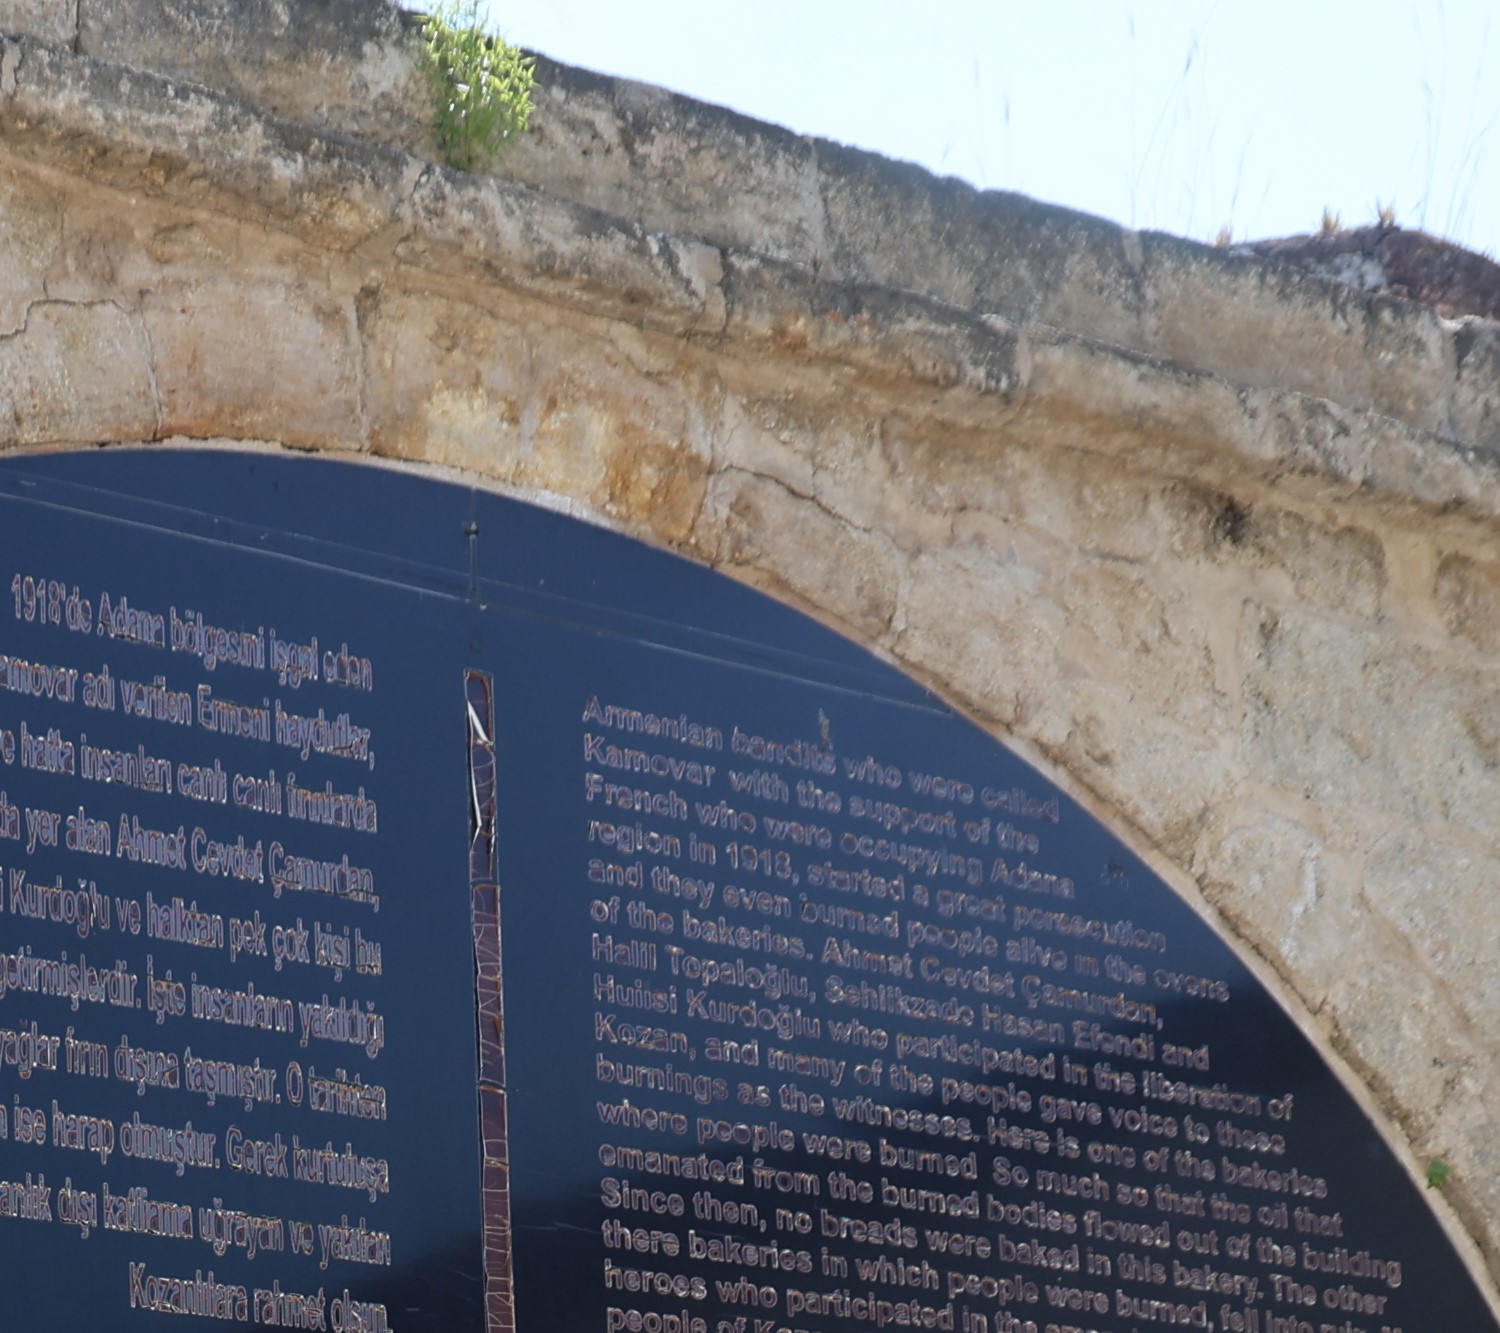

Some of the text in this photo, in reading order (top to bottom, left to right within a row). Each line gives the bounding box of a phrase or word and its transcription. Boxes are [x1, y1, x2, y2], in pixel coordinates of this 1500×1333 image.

[584, 775, 1074, 898] French who were occupying Adana
[590, 894, 620, 924] of
[625, 899, 674, 934] the
[682, 908, 813, 960] bakeries.
[820, 936, 913, 979] Ahmet
[919, 957, 1015, 998] Cevdet
[594, 1011, 696, 1061] Kozan,
[704, 1036, 759, 1066] and
[767, 1046, 846, 1087] many
[852, 1058, 882, 1087] of
[887, 1063, 933, 1095] the
[941, 1076, 1032, 1114] people
[1038, 1094, 1102, 1125] gave
[1106, 1105, 1178, 1138] voice
[1182, 1114, 1209, 1144] to
[595, 1097, 687, 1134] where
[696, 1117, 795, 1153] people
[801, 1131, 872, 1163] were
[992, 1155, 1030, 1187] So
[1035, 1168, 1109, 1201] much
[1116, 1182, 1148, 1207] so
[1153, 1183, 1205, 1217] that
[1209, 1192, 1251, 1223] the
[1256, 1201, 1288, 1229] oil
[1293, 1205, 1343, 1237] that
[597, 1143, 744, 1185] emanated
[749, 1157, 820, 1196] from
[826, 1170, 874, 1203] the
[985, 1192, 1077, 1234] bodies
[1081, 1209, 1170, 1248] flowed
[1176, 1229, 1219, 1256] out
[1225, 1232, 1251, 1260] of
[1255, 1236, 1296, 1267] the
[1301, 1241, 1401, 1288] building
[599, 1176, 1387, 1315] Since then, no breads were baked in this bakery. The other
[600, 1218, 680, 1256] there
[687, 1228, 813, 1273] bakeries
[820, 1246, 848, 1278] in
[853, 1254, 939, 1290] which
[946, 1270, 1039, 1306] people
[1044, 1284, 1109, 1314] were
[1115, 1288, 1214, 1333] burned,
[603, 1257, 708, 1300] heroes
[714, 1275, 778, 1308] who
[785, 1287, 954, 1330] participated
